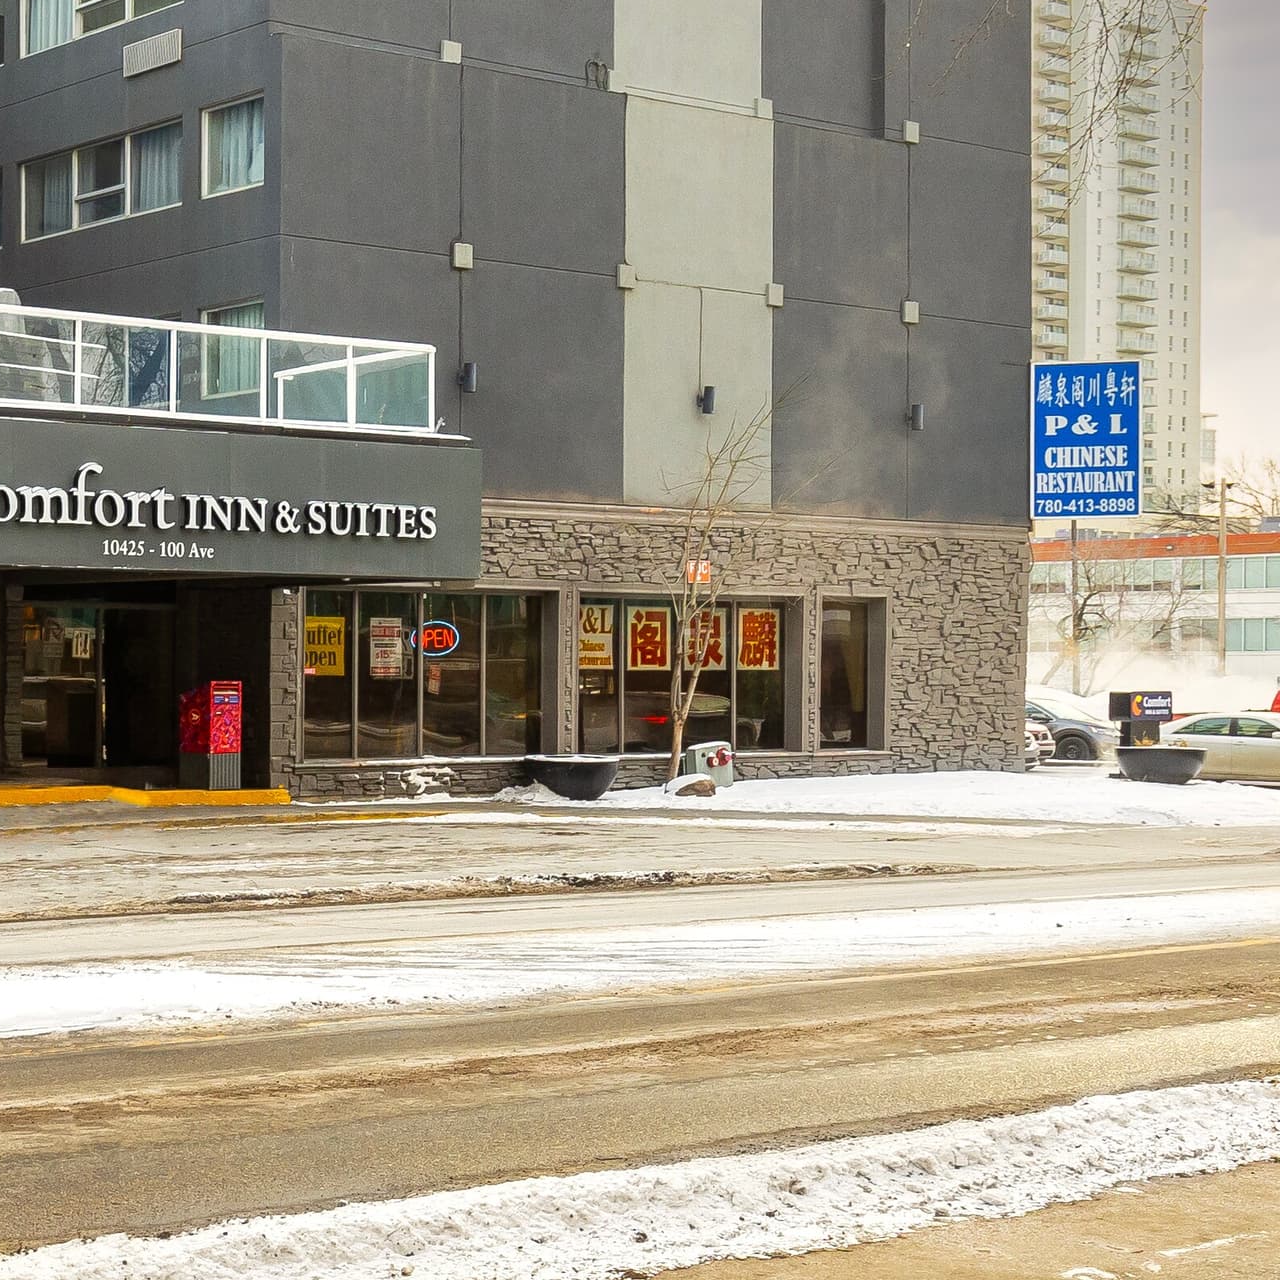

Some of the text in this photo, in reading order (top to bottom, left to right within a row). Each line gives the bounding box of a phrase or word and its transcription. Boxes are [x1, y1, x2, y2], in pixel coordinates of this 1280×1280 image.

[1044, 413, 1128, 436] P & L
[1044, 445, 1128, 469] CHINESE
[1036, 470, 1136, 494] RESTAURANT
[182, 493, 268, 533] INN
[274, 500, 301, 534] &
[307, 500, 438, 540] SUITES
[1036, 498, 1136, 513] 780-413-8898
[102, 539, 145, 557] 10425
[159, 541, 185, 558] 100
[188, 543, 215, 559] Ave
[579, 607, 612, 634] &L
[305, 624, 342, 645] uffet
[630, 609, 668, 667] 阁
